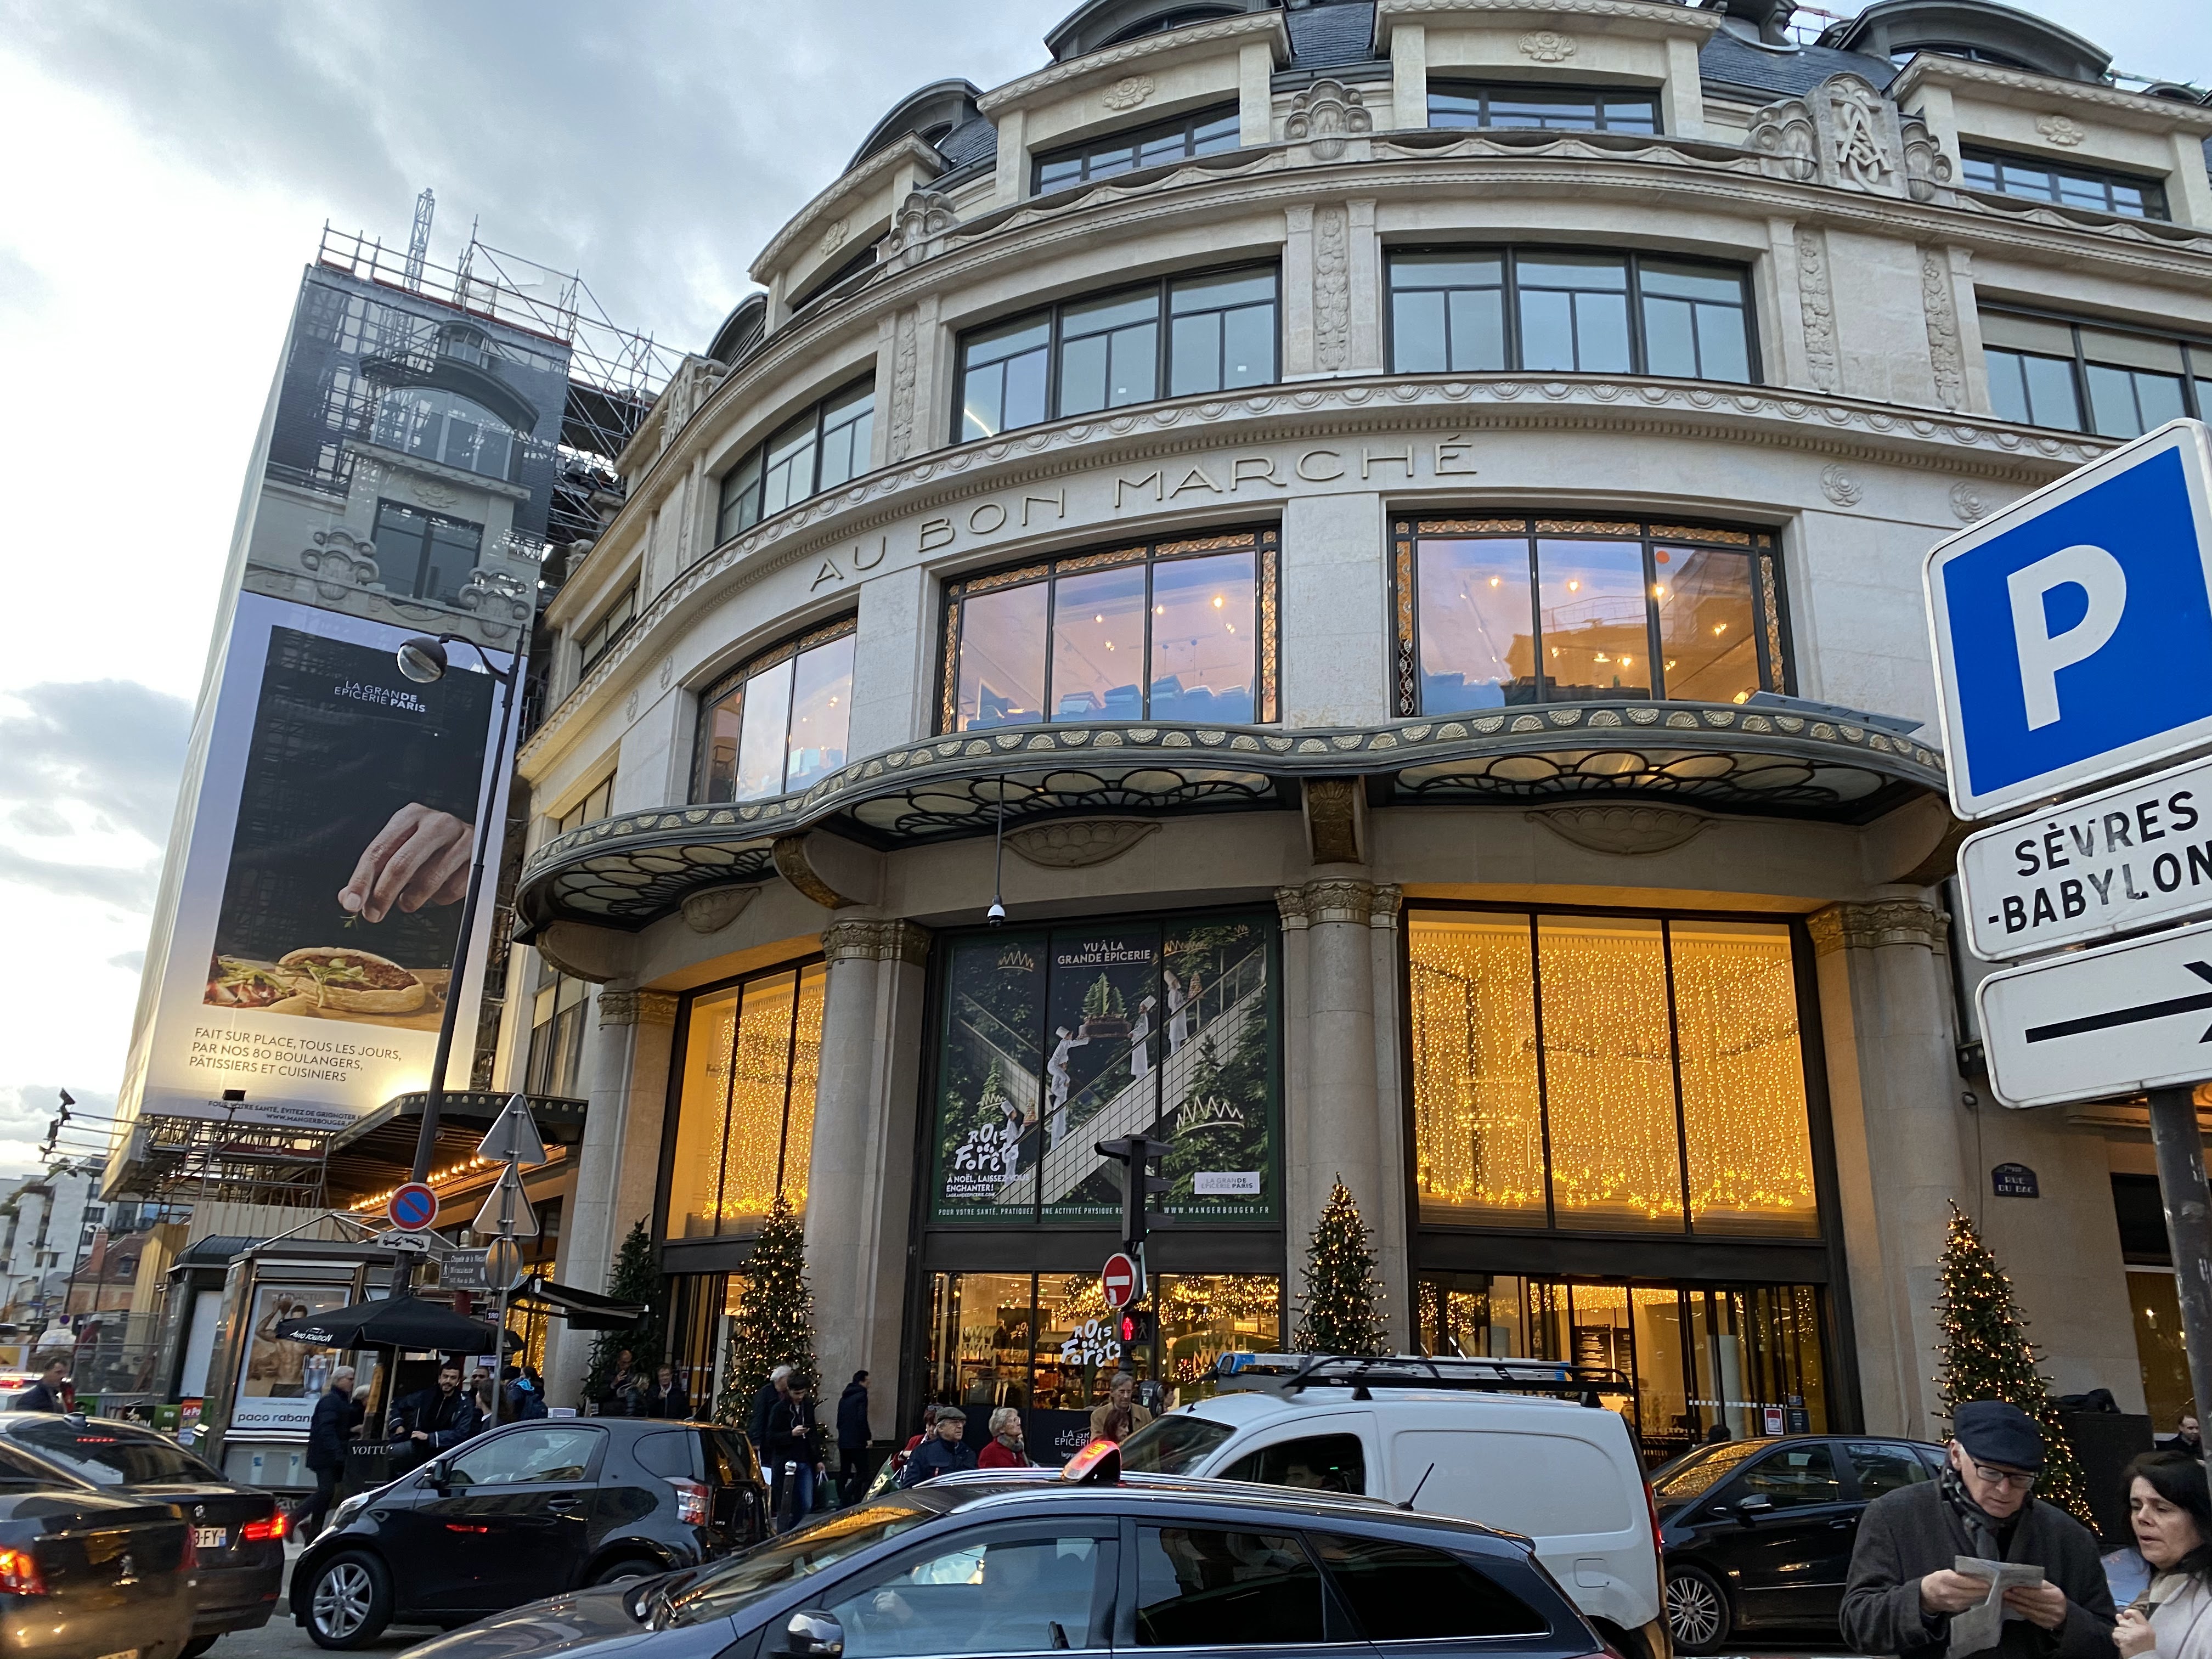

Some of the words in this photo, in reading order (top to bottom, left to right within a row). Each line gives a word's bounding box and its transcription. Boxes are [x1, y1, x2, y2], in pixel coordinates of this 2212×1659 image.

[809, 535, 887, 592] AU
[918, 487, 1064, 553] BON
[1114, 433, 1477, 507] MARCHÉ
[2007, 544, 2127, 731] P
[346, 680, 361, 691] LA
[364, 685, 417, 703] GRANDE
[334, 686, 387, 704] EPICERIE
[390, 698, 426, 713] PARIS
[2015, 791, 2199, 877] SÈVRES
[1083, 943, 1098, 952] VU
[1100, 940, 1109, 952] À
[1111, 941, 1124, 951] LA
[1057, 953, 1102, 964] GRANDE
[1104, 949, 1150, 962] ÉPICERIE
[195, 1028, 223, 1040] FAIT
[225, 1030, 250, 1043] SUR
[254, 1034, 296, 1049] PLACE,
[300, 1039, 332, 1052] TOUS
[335, 1043, 356, 1054] LES
[358, 1046, 402, 1062] JOURS,
[192, 1042, 217, 1054] PAR
[221, 1045, 249, 1057] NOS
[252, 1048, 271, 1059] 80
[275, 1051, 363, 1071] BOULANGERS,
[189, 1054, 258, 1072] PÂTISSIERS
[261, 1063, 276, 1074] ET
[279, 1065, 346, 1082] CUISINIERS
[281, 1107, 304, 1115] ÉVITEZ
[316, 1111, 356, 1120] GRIGNOTER
[946, 1173, 953, 1184] À
[953, 1173, 976, 1184] NOËL,
[978, 1173, 1030, 1183] LAISSEZ-VOUS
[2005, 1176, 2025, 1184] RUE
[2016, 1185, 2033, 1193] BAC
[1054, 1206, 1082, 1215] ACTIVITÉ
[238, 1413, 269, 1423] paco
[1062, 1430, 1074, 1438] LA
